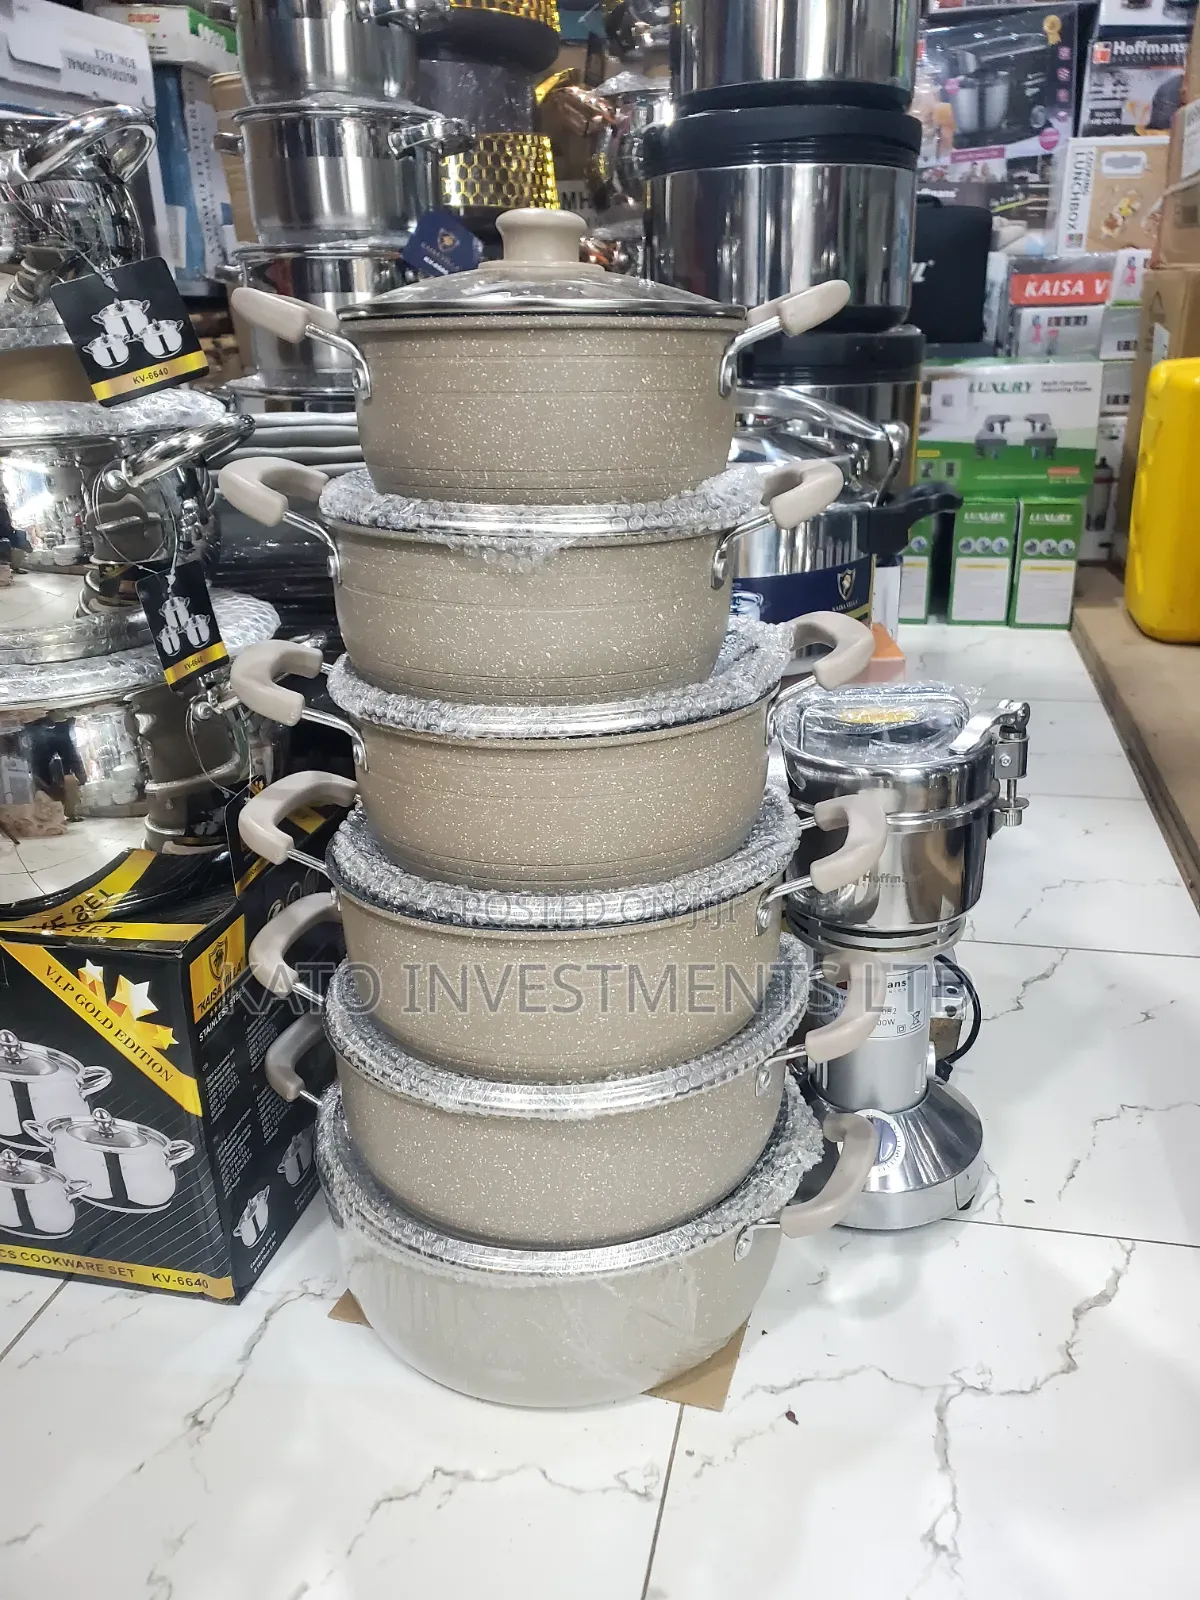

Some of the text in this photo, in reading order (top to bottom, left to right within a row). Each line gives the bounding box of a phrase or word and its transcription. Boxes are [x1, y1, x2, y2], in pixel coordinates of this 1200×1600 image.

[1112, 40, 1186, 56] Hoffmans
[1067, 151, 1087, 230] LUNCHBOX
[1024, 279, 1085, 298] KAISA
[132, 366, 169, 386] KV-6640
[967, 380, 1034, 394] LUXURY
[45, 964, 174, 1082] V.I.P GOLD EDITION
[199, 1004, 230, 1042] STAINLESS
[20, 1251, 105, 1274] COOKWARE
[108, 1264, 136, 1279] SET
[152, 1272, 209, 1290] KV-6640
